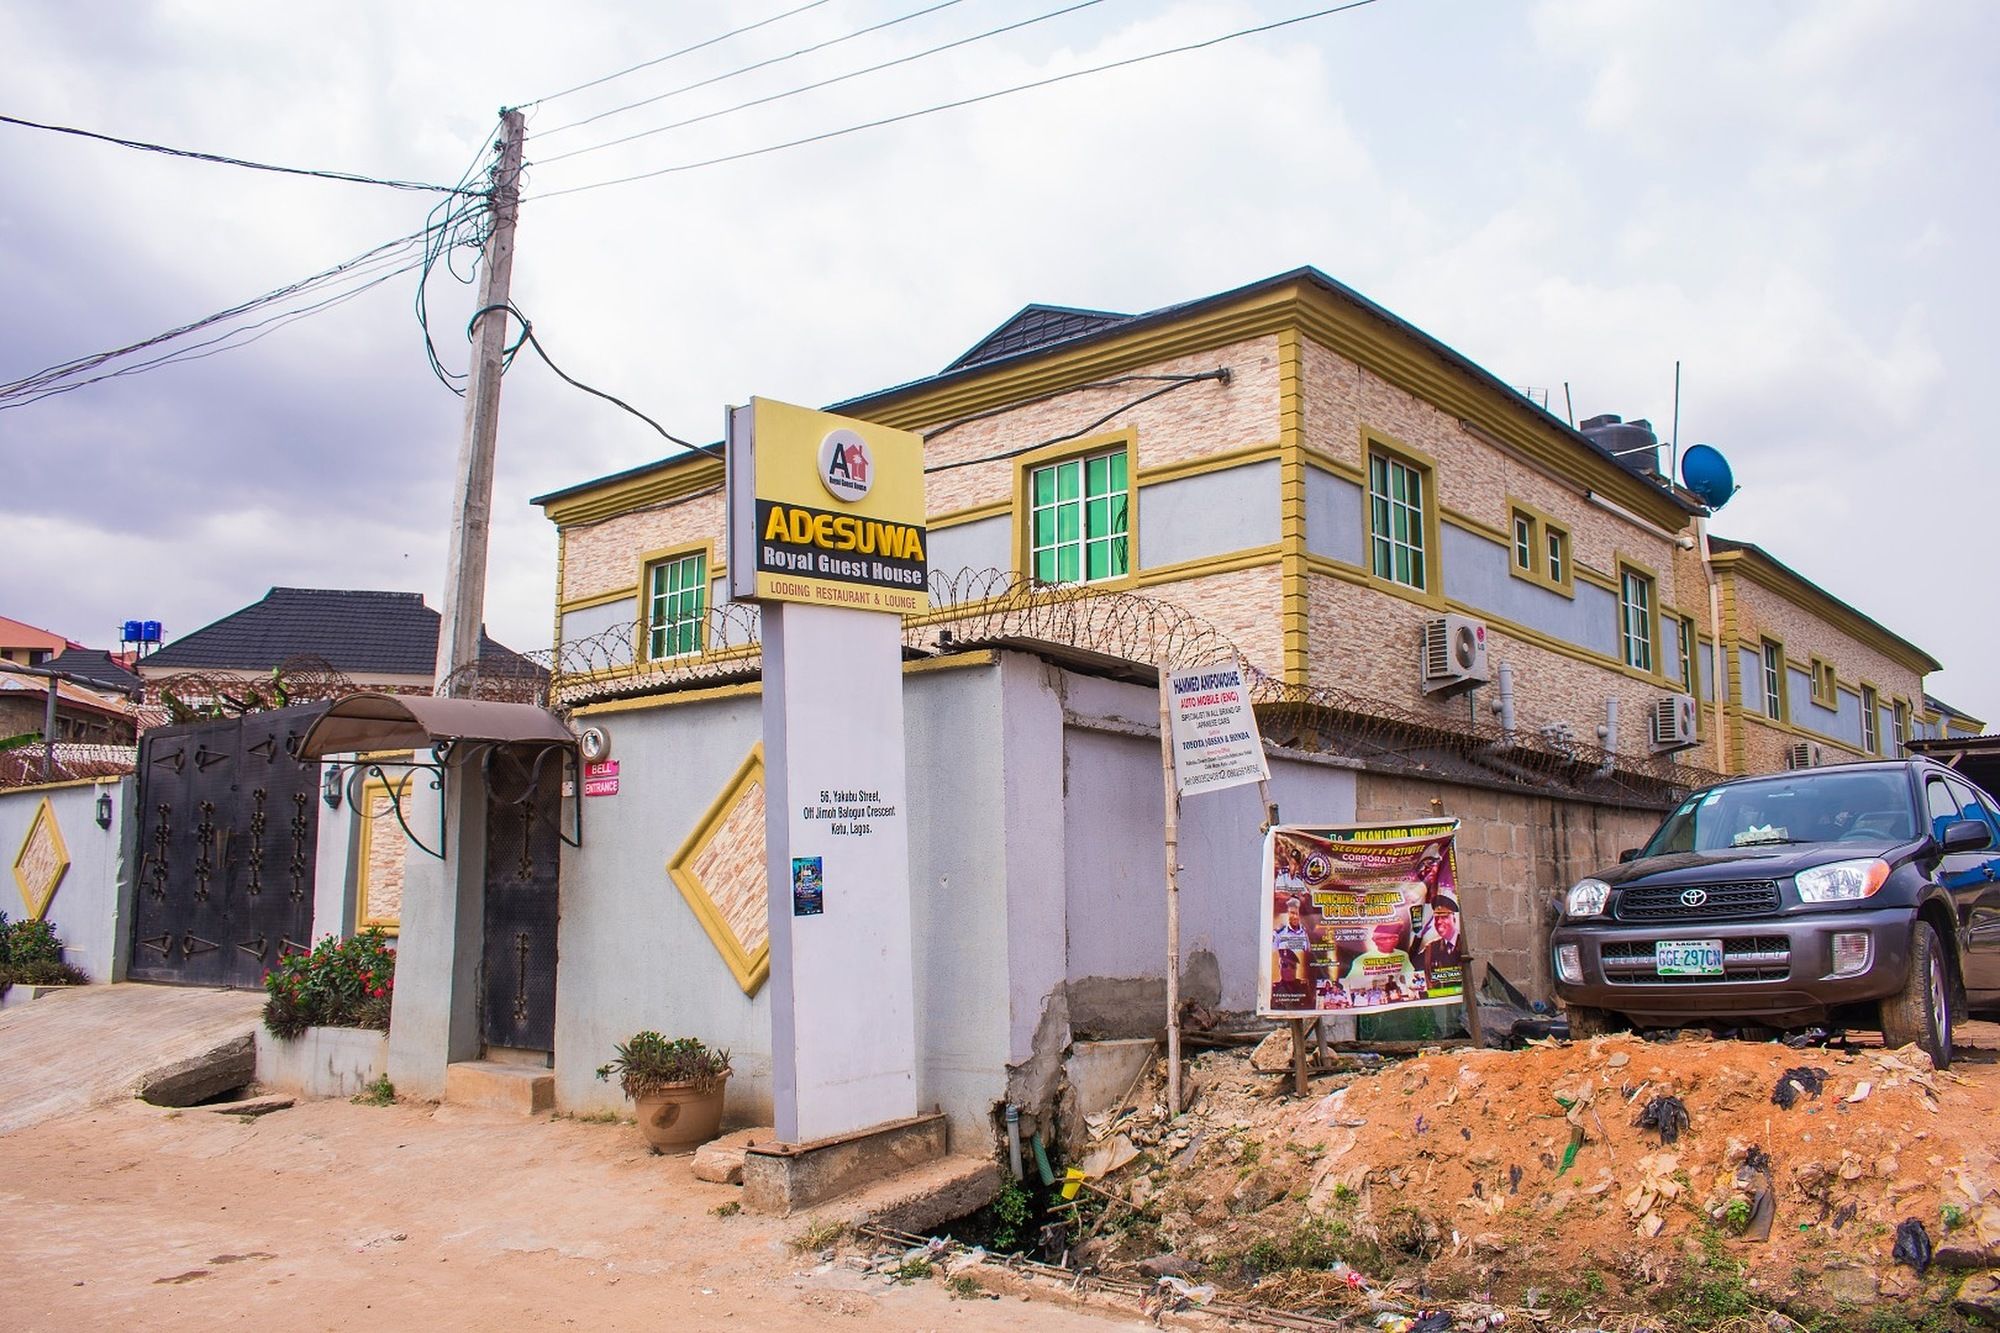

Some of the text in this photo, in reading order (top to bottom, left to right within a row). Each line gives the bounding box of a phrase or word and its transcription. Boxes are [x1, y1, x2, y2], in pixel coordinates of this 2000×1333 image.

[765, 506, 925, 562] ADESUWA
[763, 546, 922, 585] Royal Guest House
[770, 581, 917, 610] LODGING RESTAURANT & LOUNGE
[1173, 676, 1199, 694] HAMMED
[1180, 697, 1196, 709] AUTO
[1197, 693, 1220, 706] MOBILE
[1182, 739, 1204, 750] TOYOTA
[1230, 731, 1250, 742] HONDA
[592, 763, 611, 774] BELL
[585, 781, 617, 794] ENTRANCE
[833, 790, 858, 803] Yakubu
[803, 806, 814, 819] Off
[815, 806, 836, 820] Jimoh
[838, 806, 865, 820] Balogun
[1410, 825, 1454, 837] JUNCTION
[1332, 844, 1385, 855] SECURITY
[1342, 854, 1397, 864] CORPORATE
